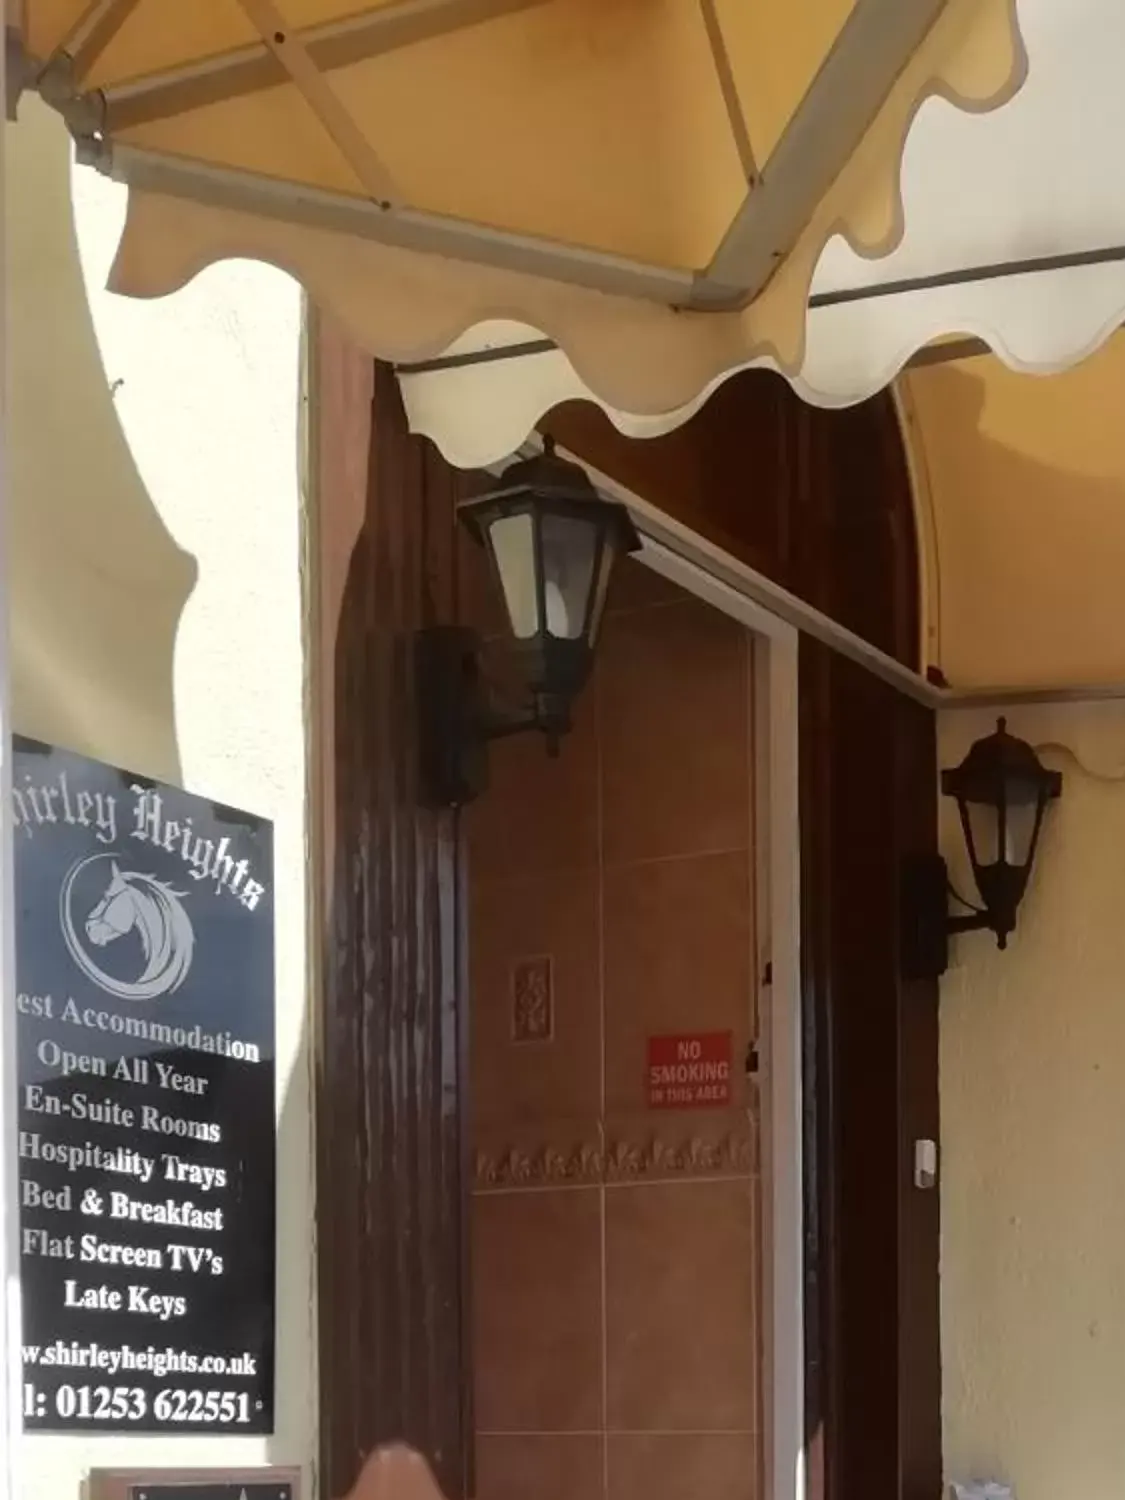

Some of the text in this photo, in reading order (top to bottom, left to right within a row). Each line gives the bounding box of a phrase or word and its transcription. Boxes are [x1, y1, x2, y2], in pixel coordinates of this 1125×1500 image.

[129, 783, 265, 911] Heights
[60, 997, 261, 1064] Accommodation
[678, 1040, 702, 1061] NO
[37, 1039, 209, 1096] Open All Year
[650, 1061, 730, 1085] SMOKING
[24, 1084, 222, 1143] En-Suite Rooms
[18, 1131, 227, 1191] Hospitality Trays
[21, 1179, 224, 1232] Bed & Breakfast
[22, 1228, 223, 1276] Flat Screen TV's
[63, 1279, 187, 1321] Late Keys
[55, 1384, 148, 1420] 01253
[153, 1389, 250, 1423] 622551
